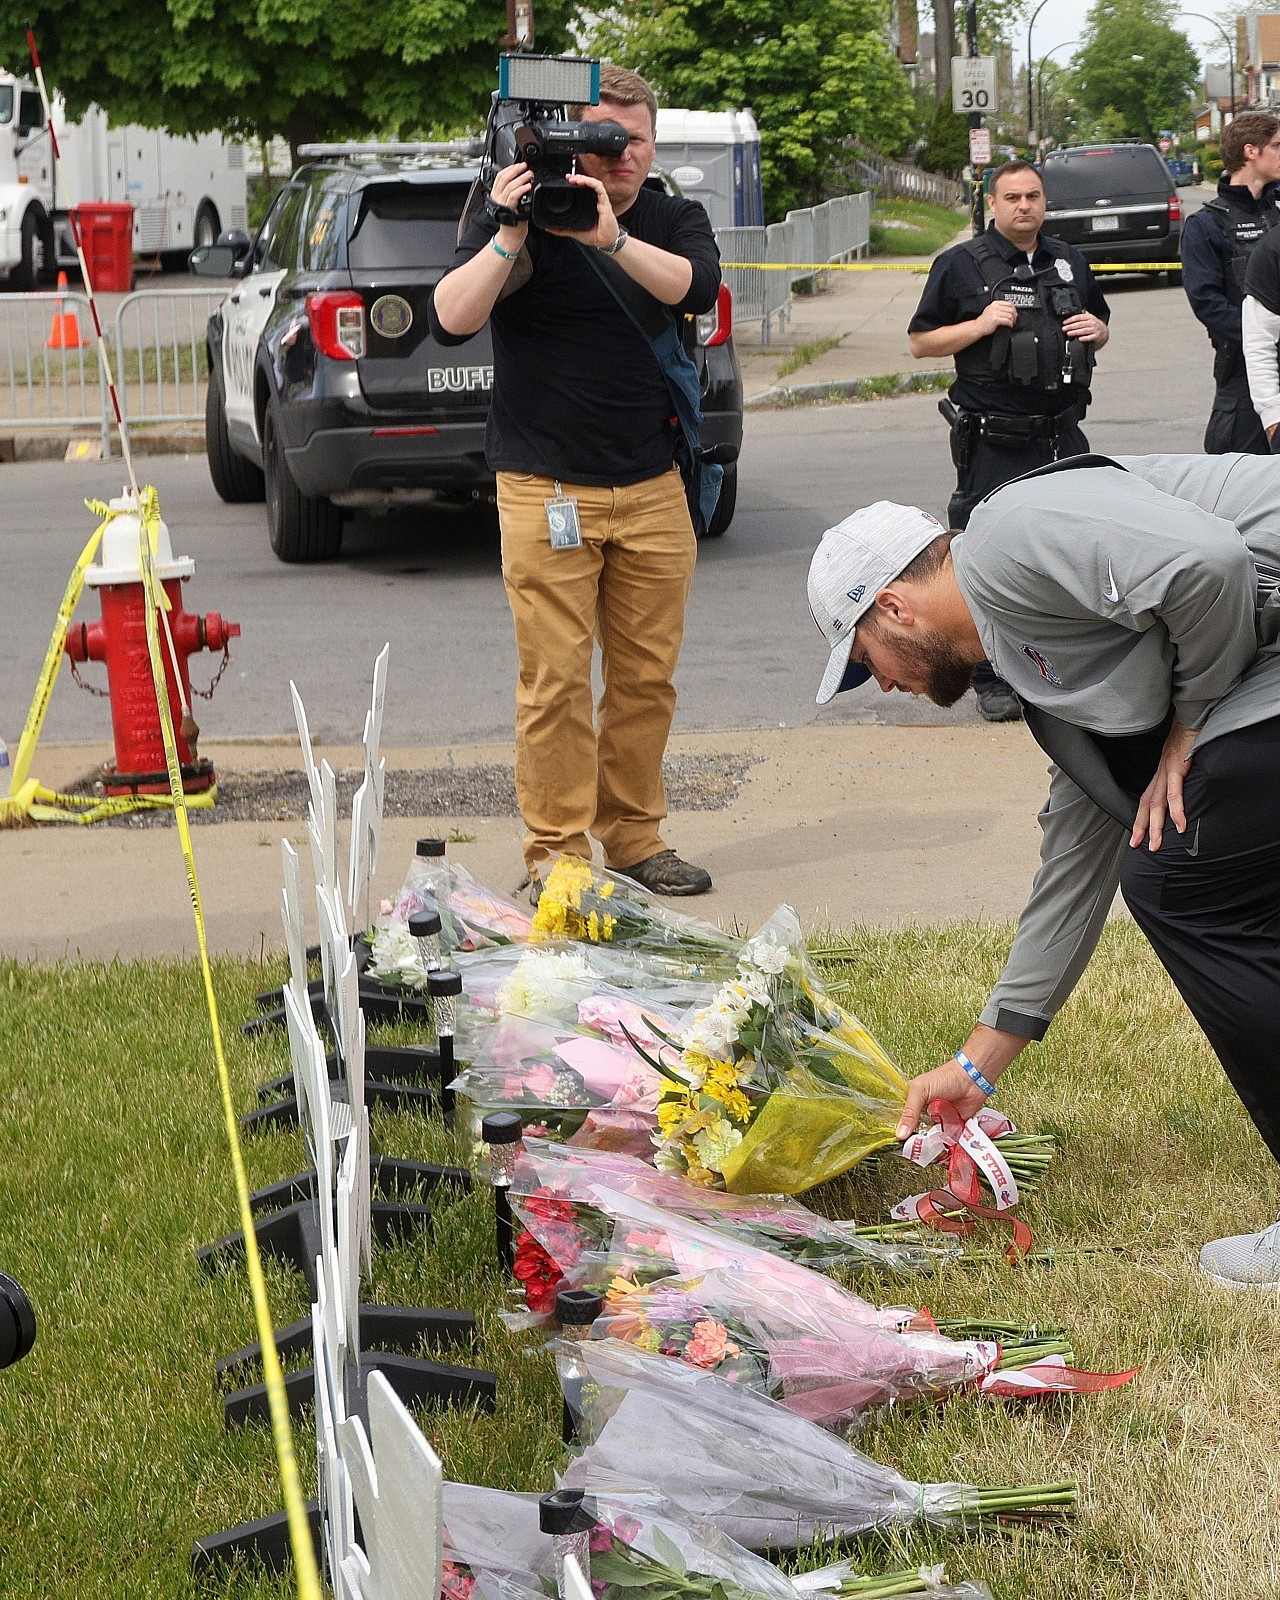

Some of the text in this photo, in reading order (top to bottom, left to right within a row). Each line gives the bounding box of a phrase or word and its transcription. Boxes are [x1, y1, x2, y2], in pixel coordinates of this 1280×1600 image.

[963, 70, 986, 78] SPEED
[964, 79, 985, 87] LIMIT
[961, 89, 989, 108] 30
[1010, 285, 1033, 293] PIAZZA
[1004, 293, 1035, 301] BUFFALO
[427, 365, 494, 393] BUFF
[981, 1152, 1008, 1188] BILLS
